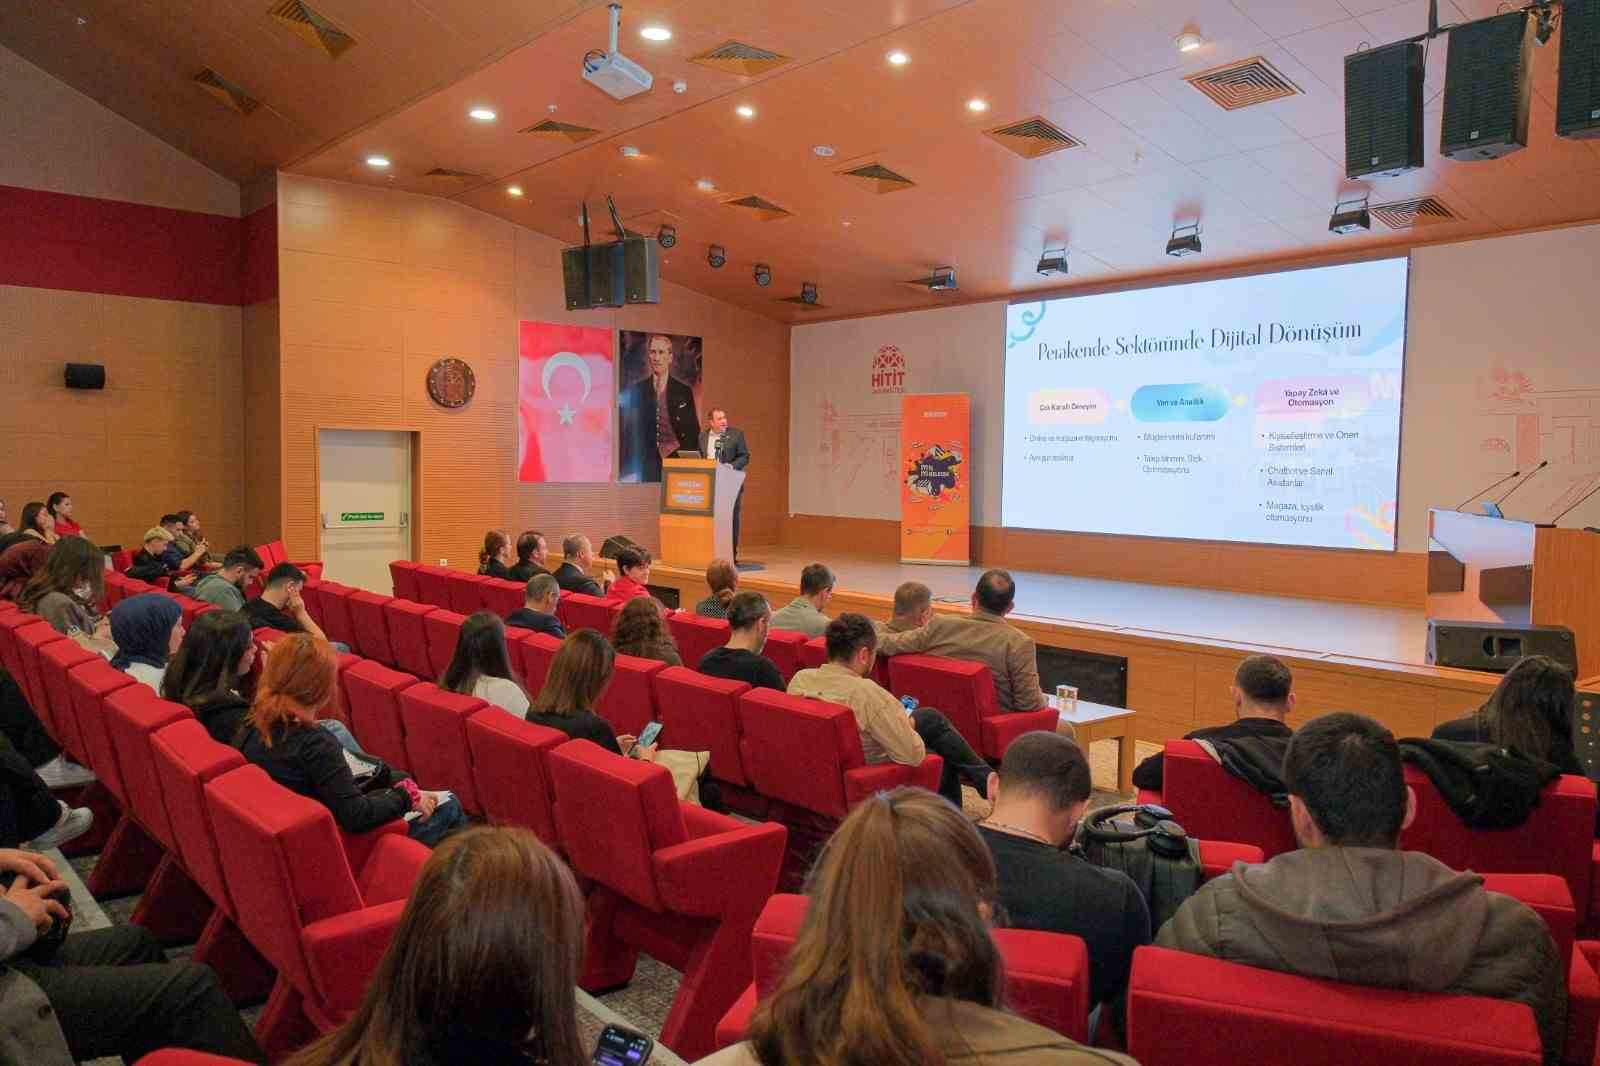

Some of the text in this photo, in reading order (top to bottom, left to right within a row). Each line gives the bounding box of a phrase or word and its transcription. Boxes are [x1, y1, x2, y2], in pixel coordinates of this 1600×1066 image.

[1115, 329, 1204, 355] Sektöründe
[1212, 323, 1261, 351] Dijital
[1269, 321, 1361, 344] Dönüşüm
[872, 368, 905, 387] HİTİT
[1288, 399, 1335, 407] Otomasyon
